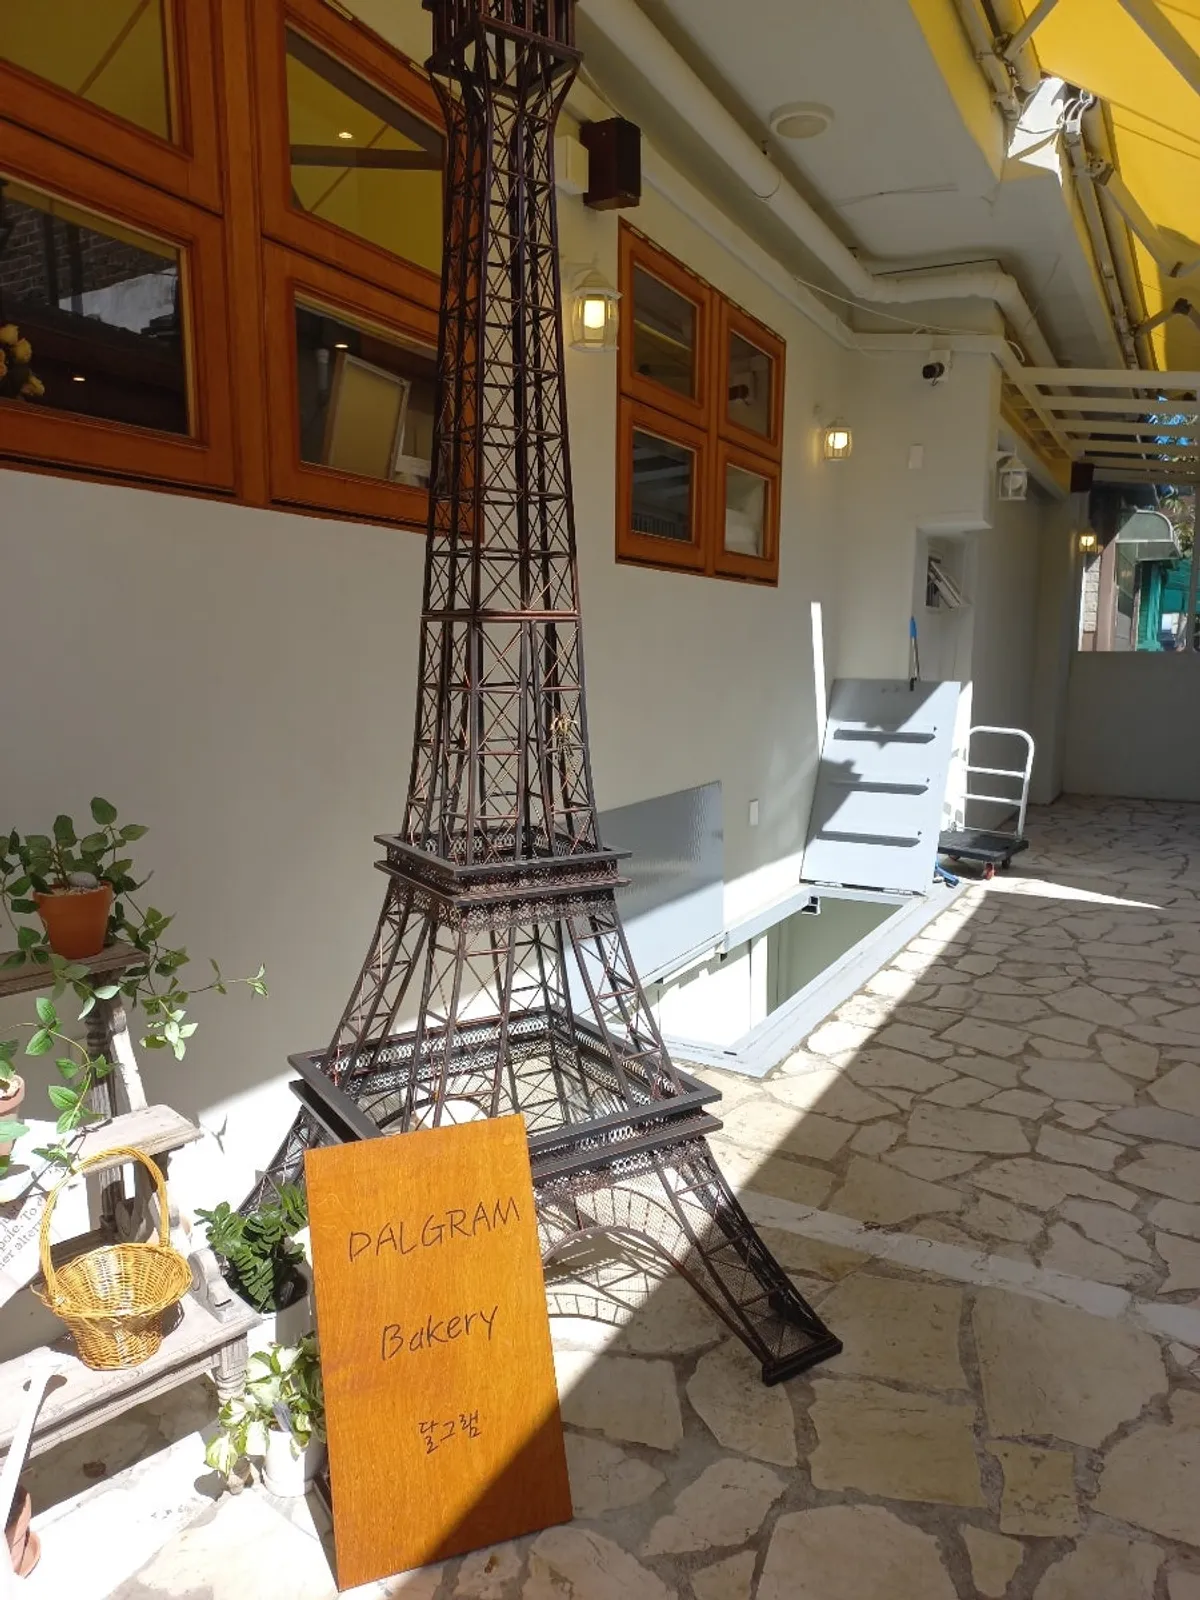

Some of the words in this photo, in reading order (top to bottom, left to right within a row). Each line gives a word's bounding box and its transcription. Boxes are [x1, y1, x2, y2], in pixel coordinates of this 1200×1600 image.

[20, 1206, 38, 1221] To
[349, 1196, 521, 1263] DALGRAM
[381, 1305, 499, 1361] Bakery
[418, 1409, 482, 1454] 달그램
